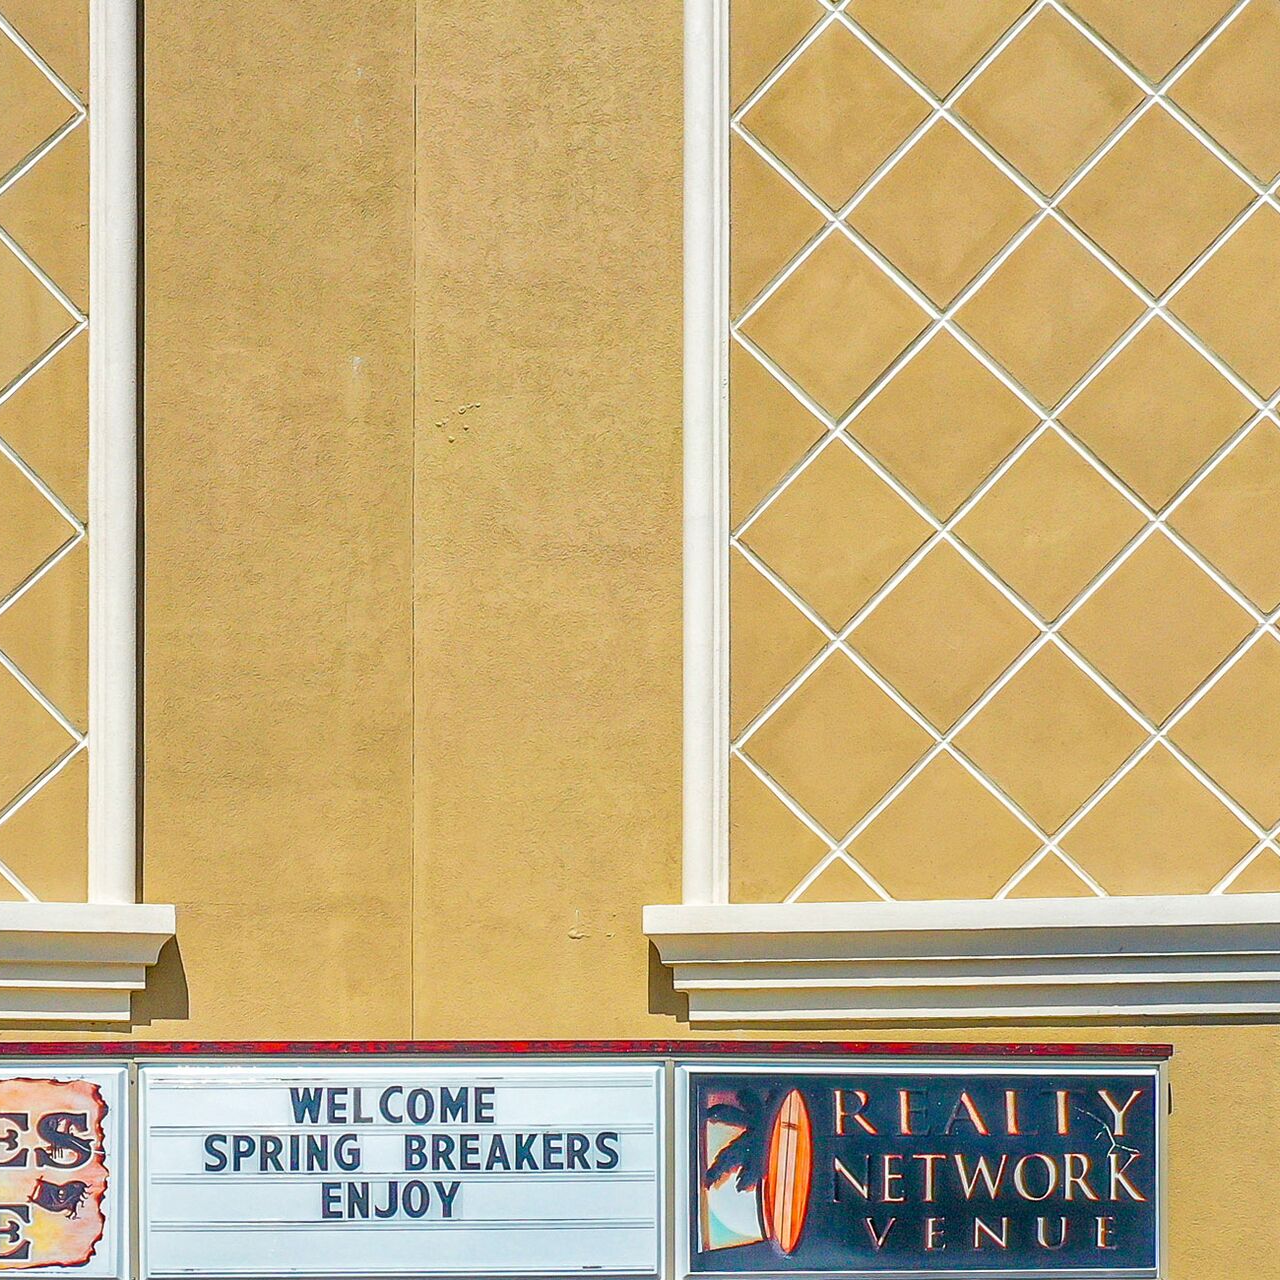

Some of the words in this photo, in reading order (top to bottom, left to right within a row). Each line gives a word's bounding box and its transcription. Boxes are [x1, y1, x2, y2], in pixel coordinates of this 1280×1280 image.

[289, 1086, 495, 1124] WELCOME
[833, 1088, 1144, 1137] REALTY
[204, 1133, 362, 1172] SPRING
[405, 1131, 619, 1171] BREAKERS
[833, 1153, 1147, 1202] NETWORK
[321, 1180, 461, 1219] ENJOY
[866, 1217, 1117, 1251] VENUE
